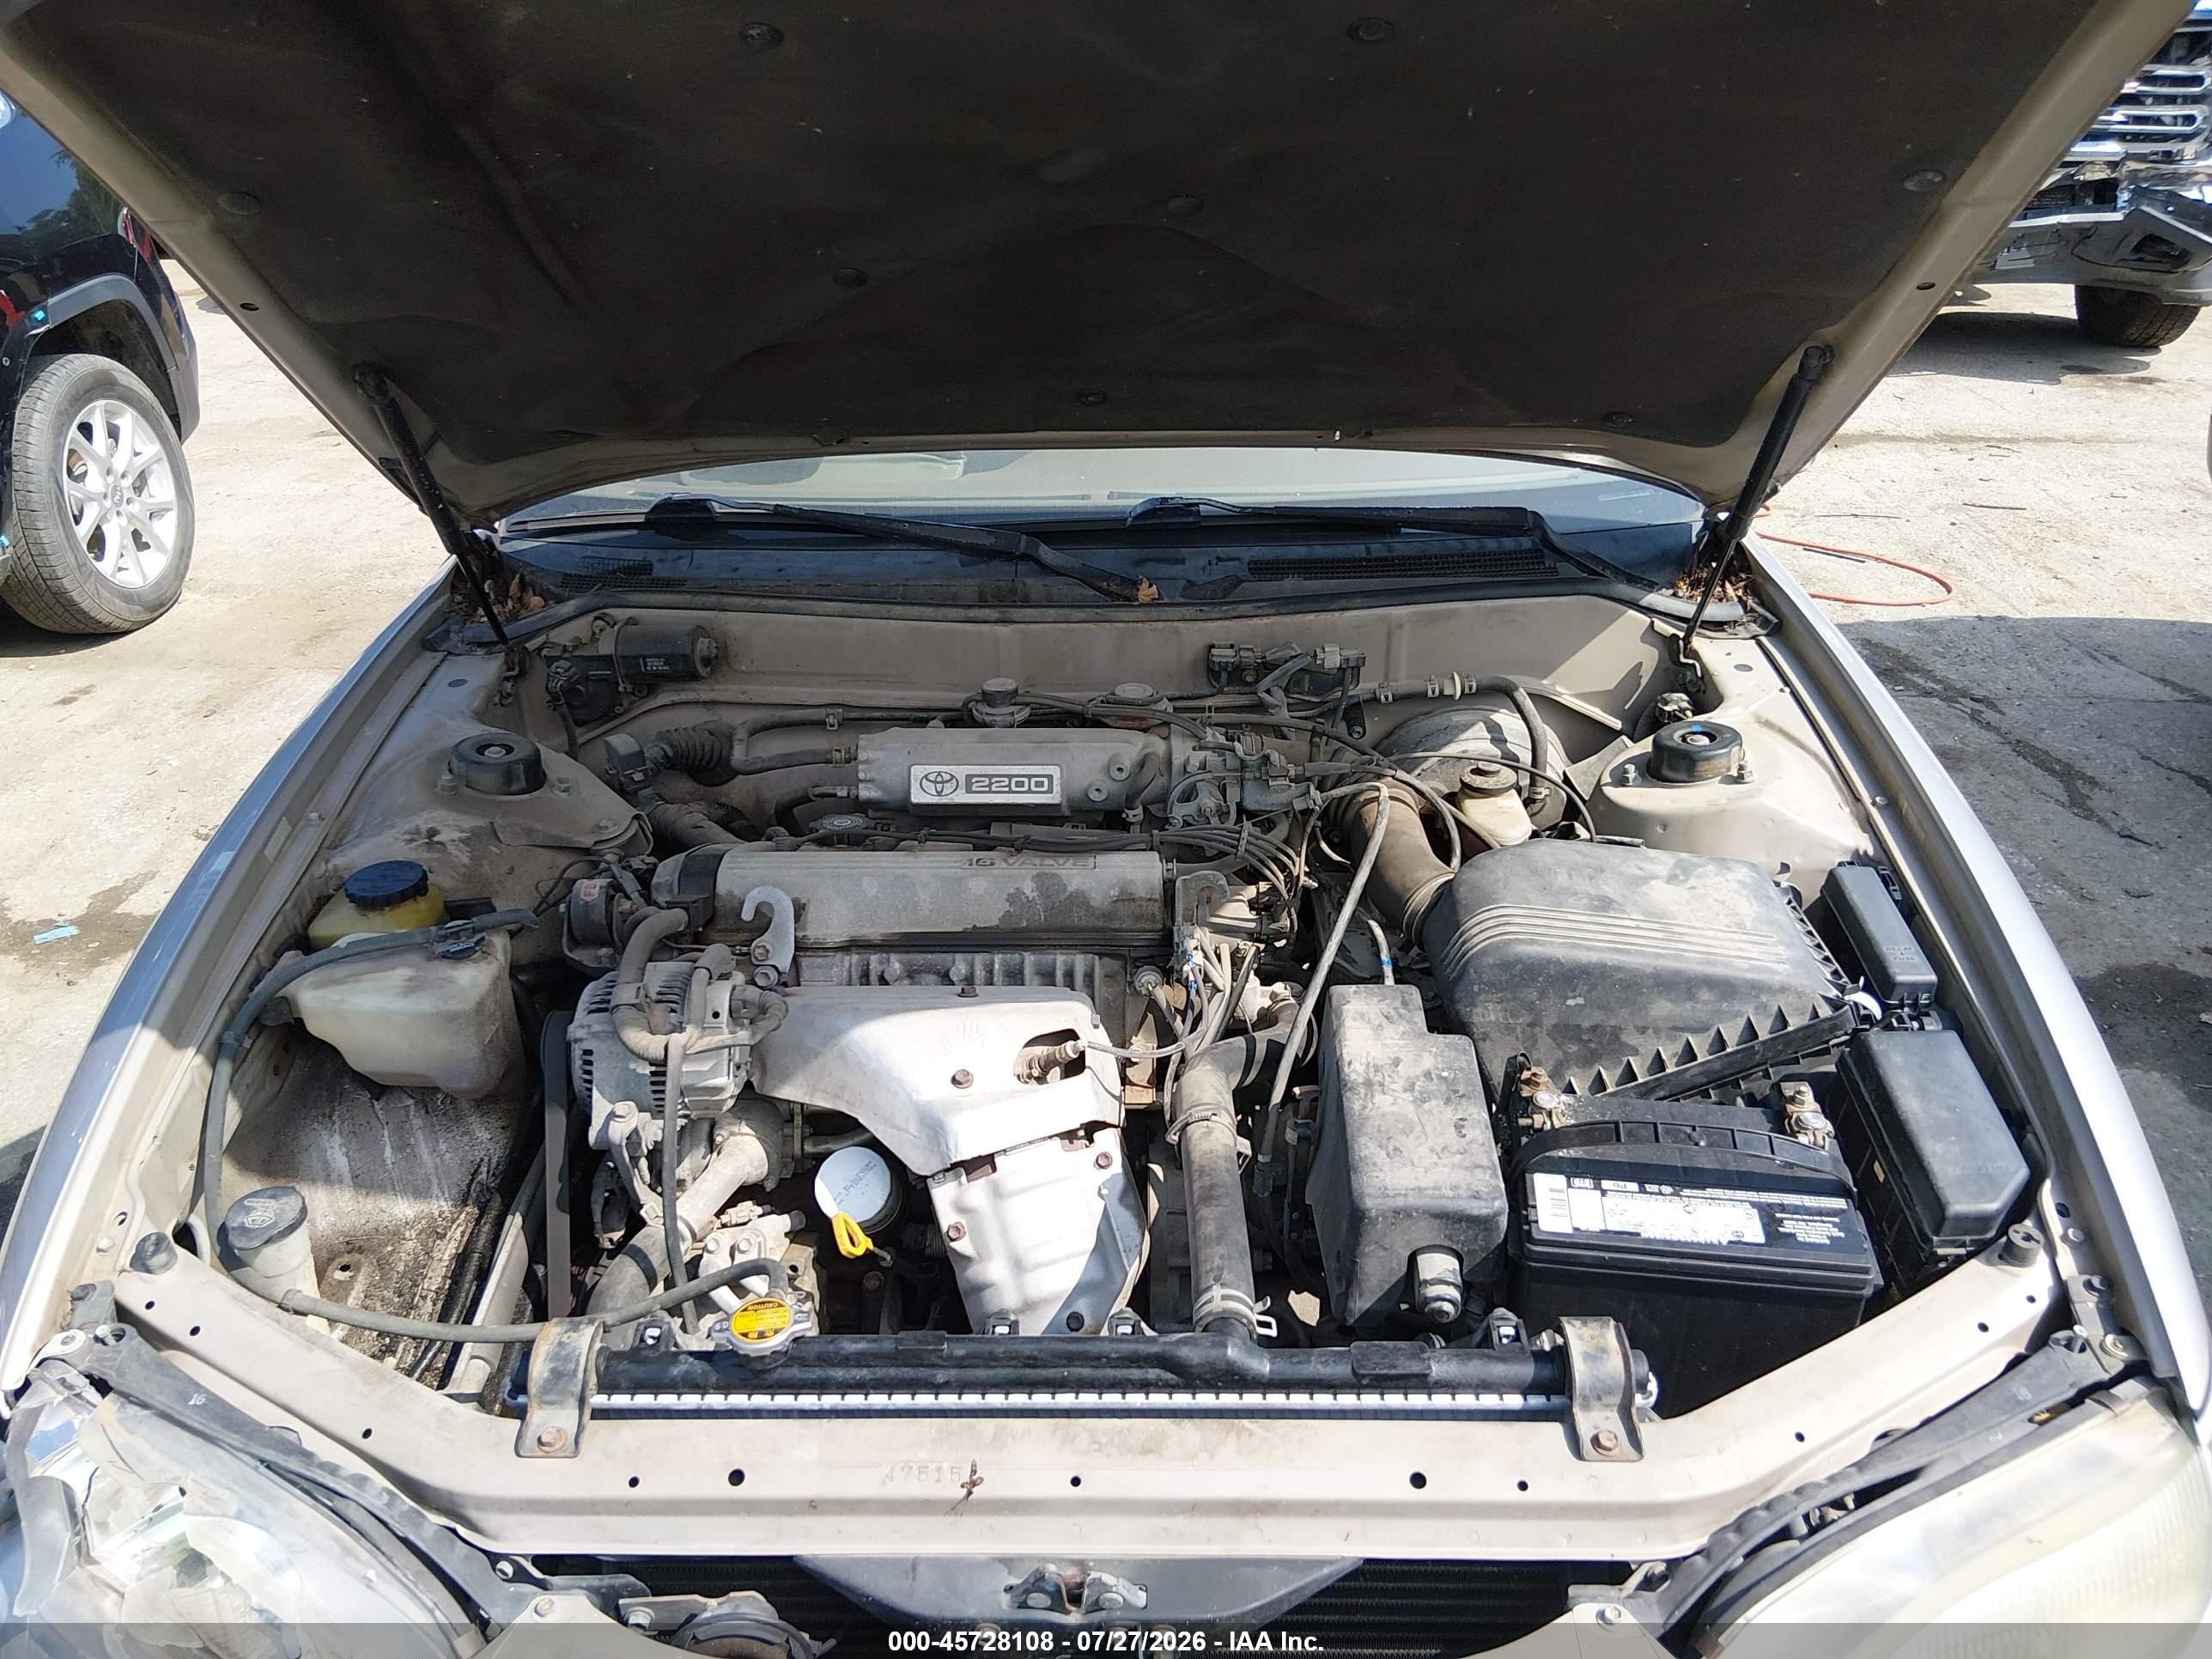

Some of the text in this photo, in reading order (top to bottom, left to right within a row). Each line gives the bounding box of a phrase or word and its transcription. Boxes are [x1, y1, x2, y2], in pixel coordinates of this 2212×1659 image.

[971, 777, 1048, 792] 2200
[967, 858, 1090, 867] 16 VALVE
[747, 1302, 779, 1310] CAUTION
[714, 1321, 729, 1331] 0.9
[188, 1393, 207, 1406] 16
